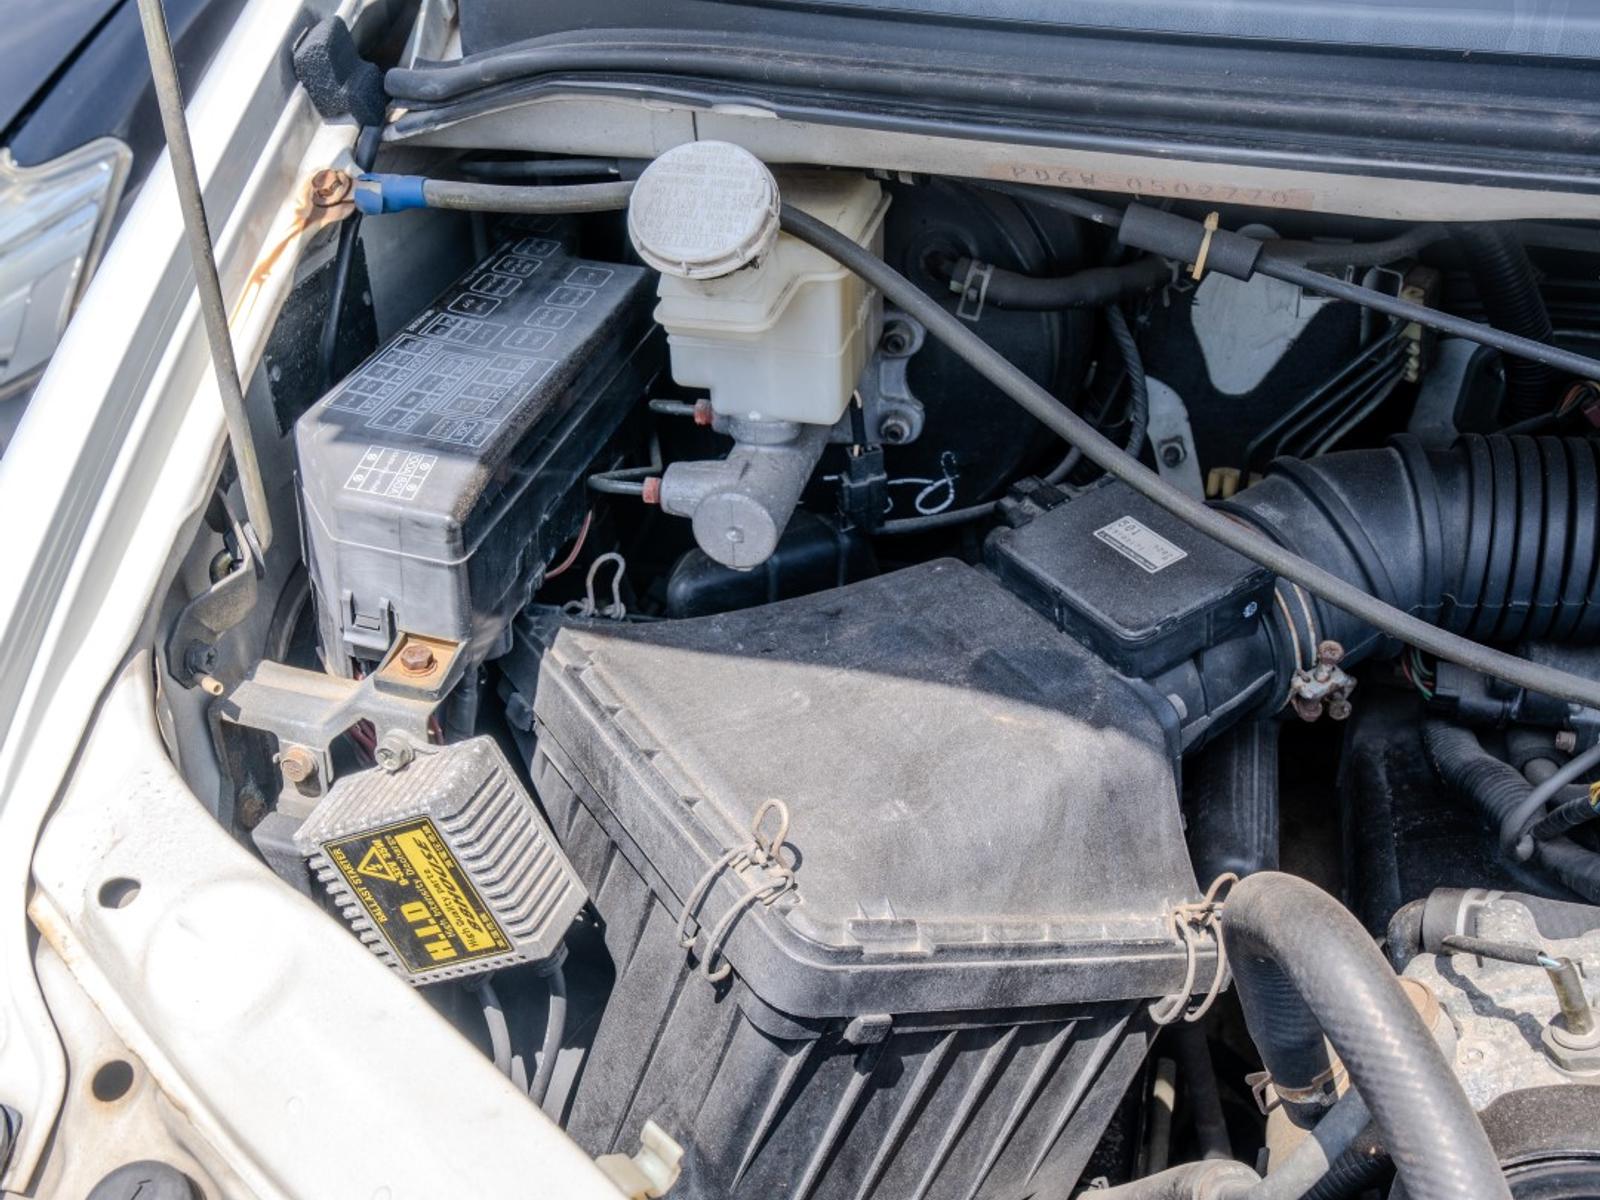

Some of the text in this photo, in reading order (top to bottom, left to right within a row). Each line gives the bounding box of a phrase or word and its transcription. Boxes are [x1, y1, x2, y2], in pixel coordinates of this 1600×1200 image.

[383, 835, 416, 876] Discharge
[331, 848, 388, 925] BALLAST STARTER
[413, 878, 442, 917] Intensity
[400, 900, 457, 961] H.I.D
[461, 928, 479, 947] High
